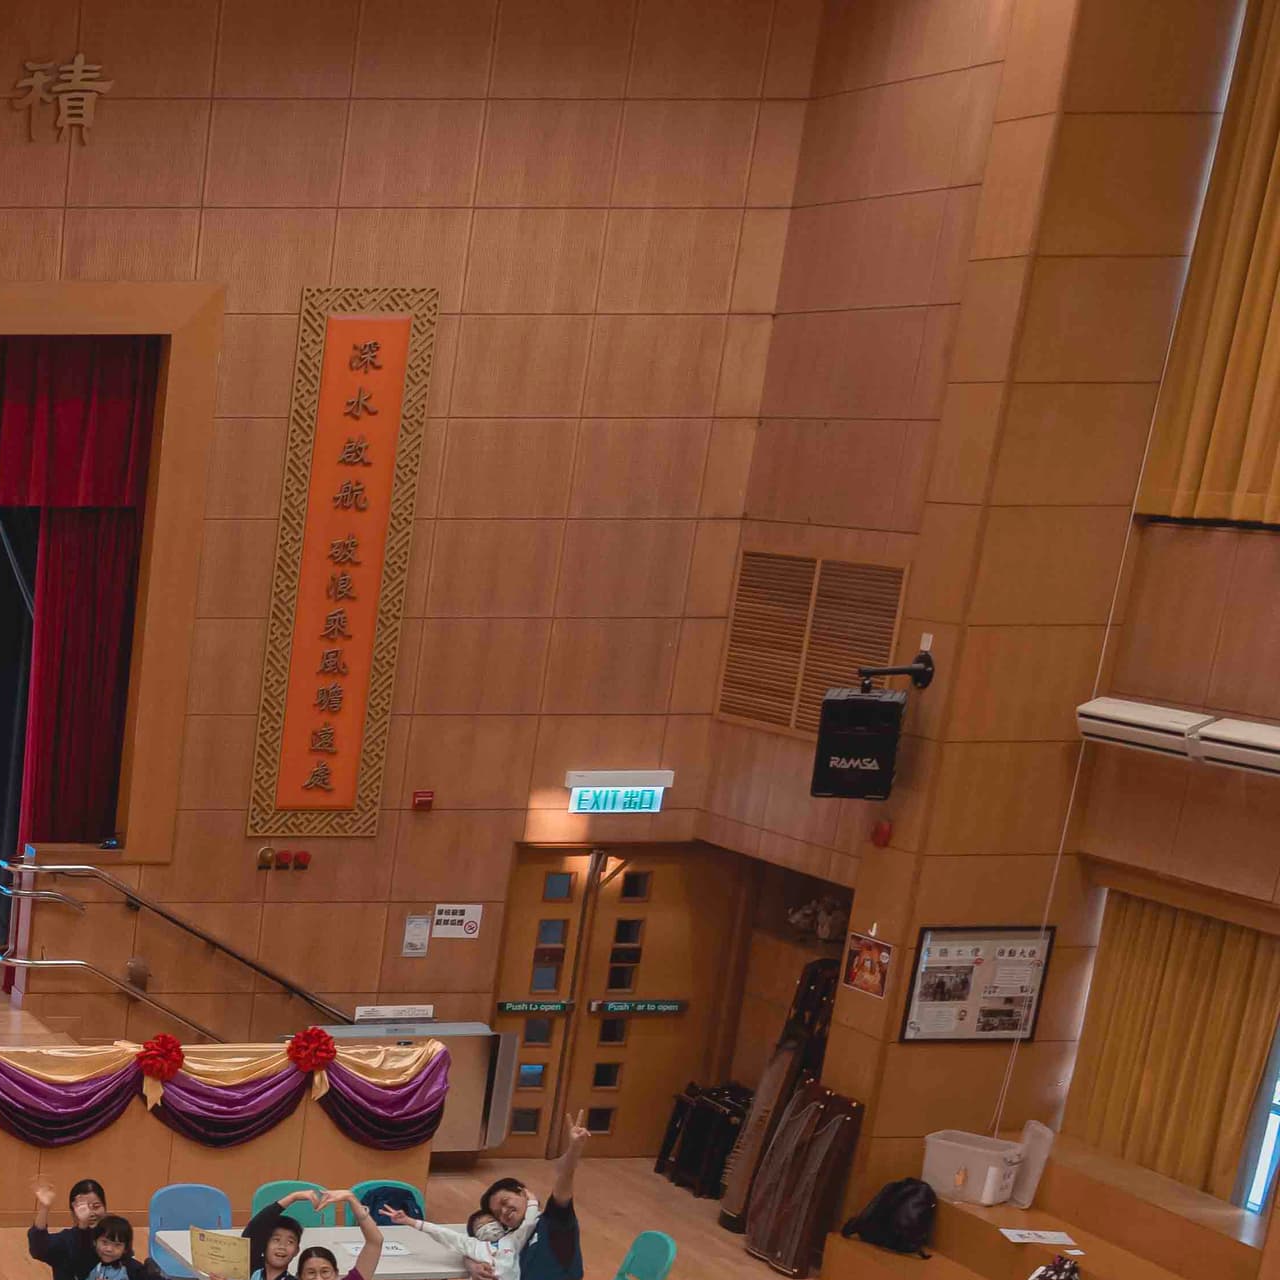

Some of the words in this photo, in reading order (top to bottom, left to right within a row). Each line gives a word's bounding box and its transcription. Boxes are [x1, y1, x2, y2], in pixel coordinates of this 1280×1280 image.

[829, 756, 880, 771] RAMSA
[576, 789, 620, 811] EXIT
[622, 789, 656, 811] 出口
